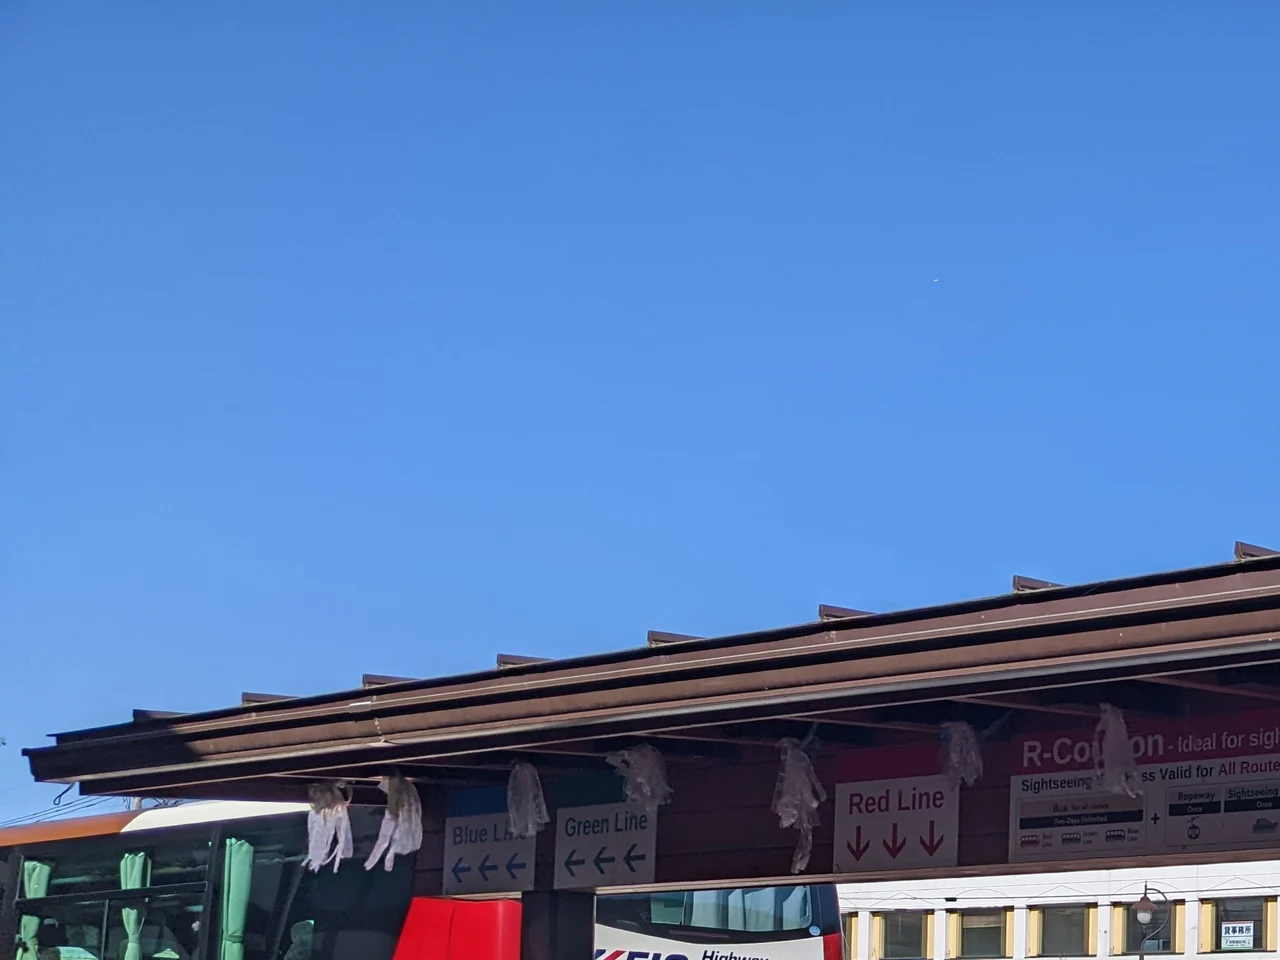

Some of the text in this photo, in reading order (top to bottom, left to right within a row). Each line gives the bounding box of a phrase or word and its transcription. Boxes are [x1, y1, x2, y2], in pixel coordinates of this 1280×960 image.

[1022, 732, 1164, 768] R-Coon
[1178, 731, 1217, 753] Ideal
[1221, 730, 1245, 749] for
[1021, 776, 1093, 794] Sightseeing
[1160, 764, 1192, 781] Valid
[1196, 763, 1215, 779] for
[1218, 763, 1236, 777] All
[849, 787, 945, 815] Red Line
[1178, 791, 1216, 801] Ropeway
[1228, 786, 1279, 799] Sightseeing
[453, 825, 488, 845] Blue
[565, 810, 648, 837] Green Line
[1224, 925, 1252, 936] 貸事務所
